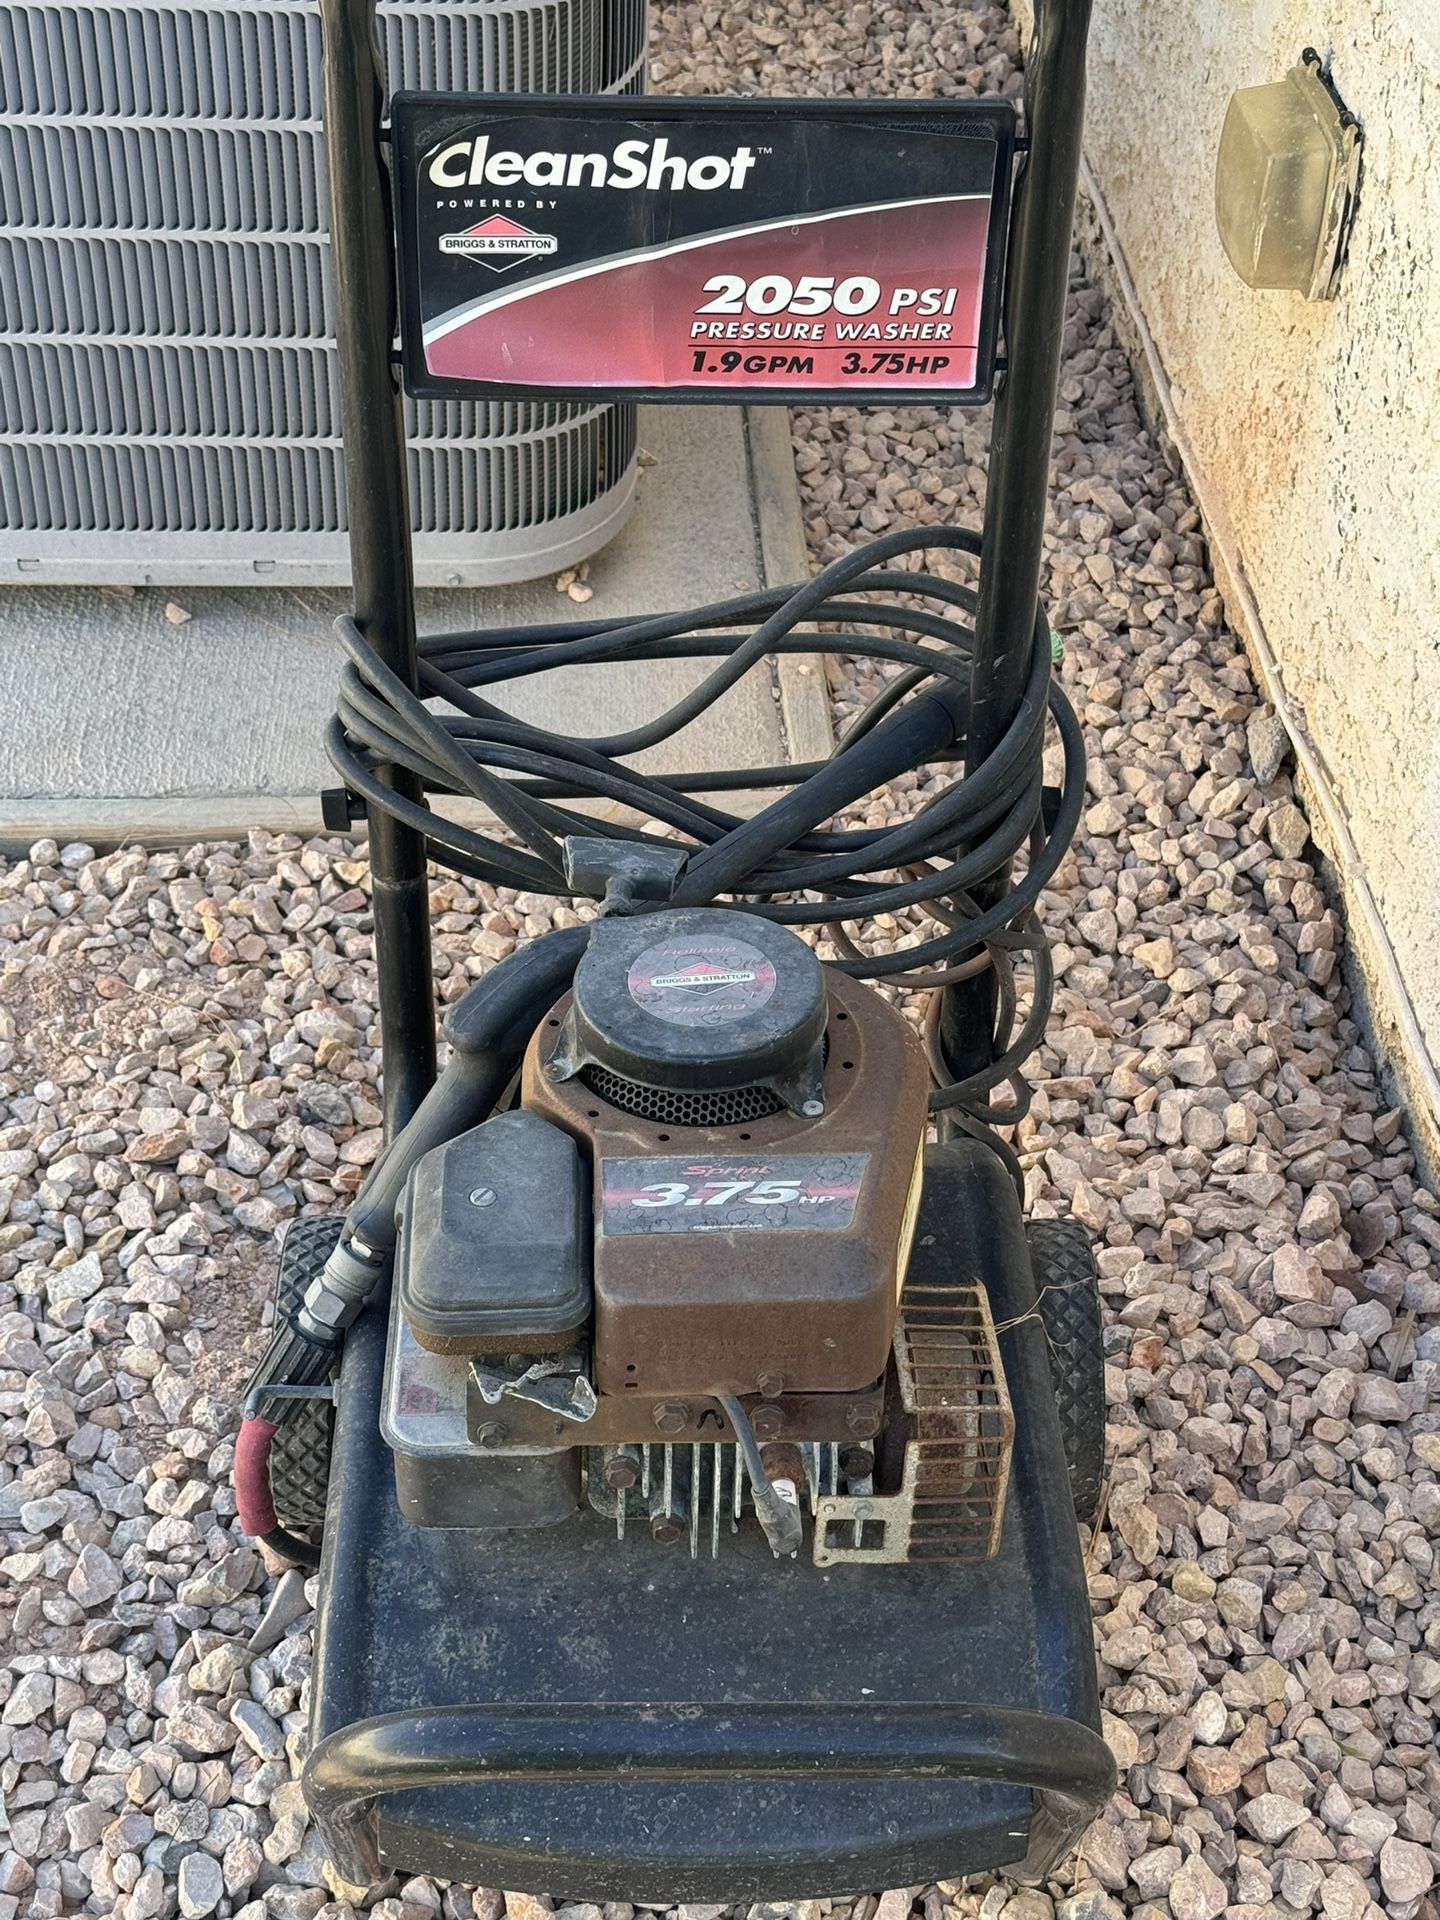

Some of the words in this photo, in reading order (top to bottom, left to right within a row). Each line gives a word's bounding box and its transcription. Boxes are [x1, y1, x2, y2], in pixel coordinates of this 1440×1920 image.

[429, 135, 756, 191] CleanShot
[437, 200, 525, 209] POWERED
[536, 200, 557, 209] BY
[445, 239, 486, 248] BRIGGS
[488, 240, 496, 248] &
[498, 240, 551, 249] STRATTON
[694, 275, 881, 317] 2050
[888, 288, 958, 316] PSI
[690, 321, 826, 341] PRESSURE
[835, 322, 953, 341] WASHER
[693, 350, 814, 374] 1.9GPM
[841, 352, 950, 374] 3.75HP
[703, 973, 750, 982] STRATTON
[682, 1165, 772, 1177] Sprint
